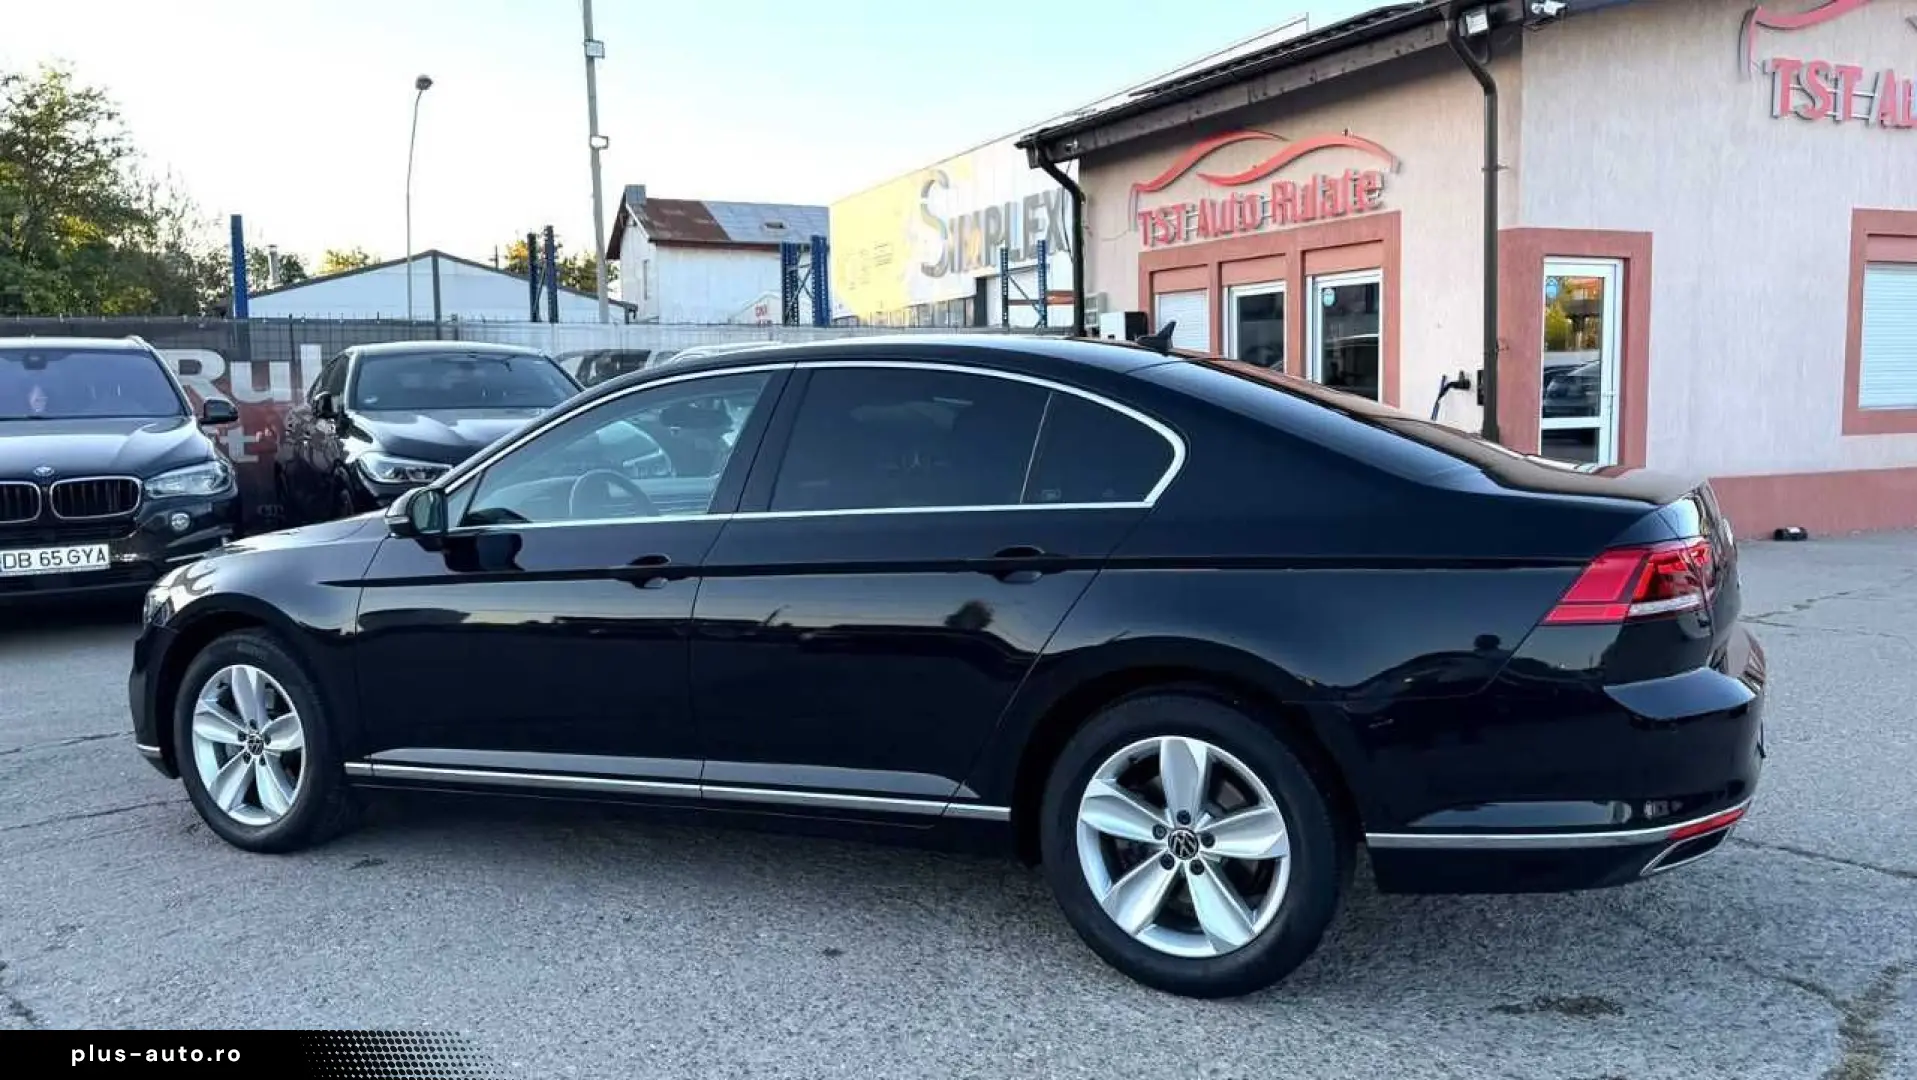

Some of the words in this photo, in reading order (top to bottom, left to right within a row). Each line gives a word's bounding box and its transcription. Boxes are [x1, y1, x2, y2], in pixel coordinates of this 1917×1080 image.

[1772, 57, 1864, 121] TST
[920, 168, 1072, 279] SIMPLEX
[1138, 203, 1190, 247] TST
[1196, 191, 1264, 238] Auto
[1271, 168, 1386, 225] Rulate
[2, 551, 33, 570] DB
[39, 549, 64, 567] 65
[66, 546, 107, 565] GYA
